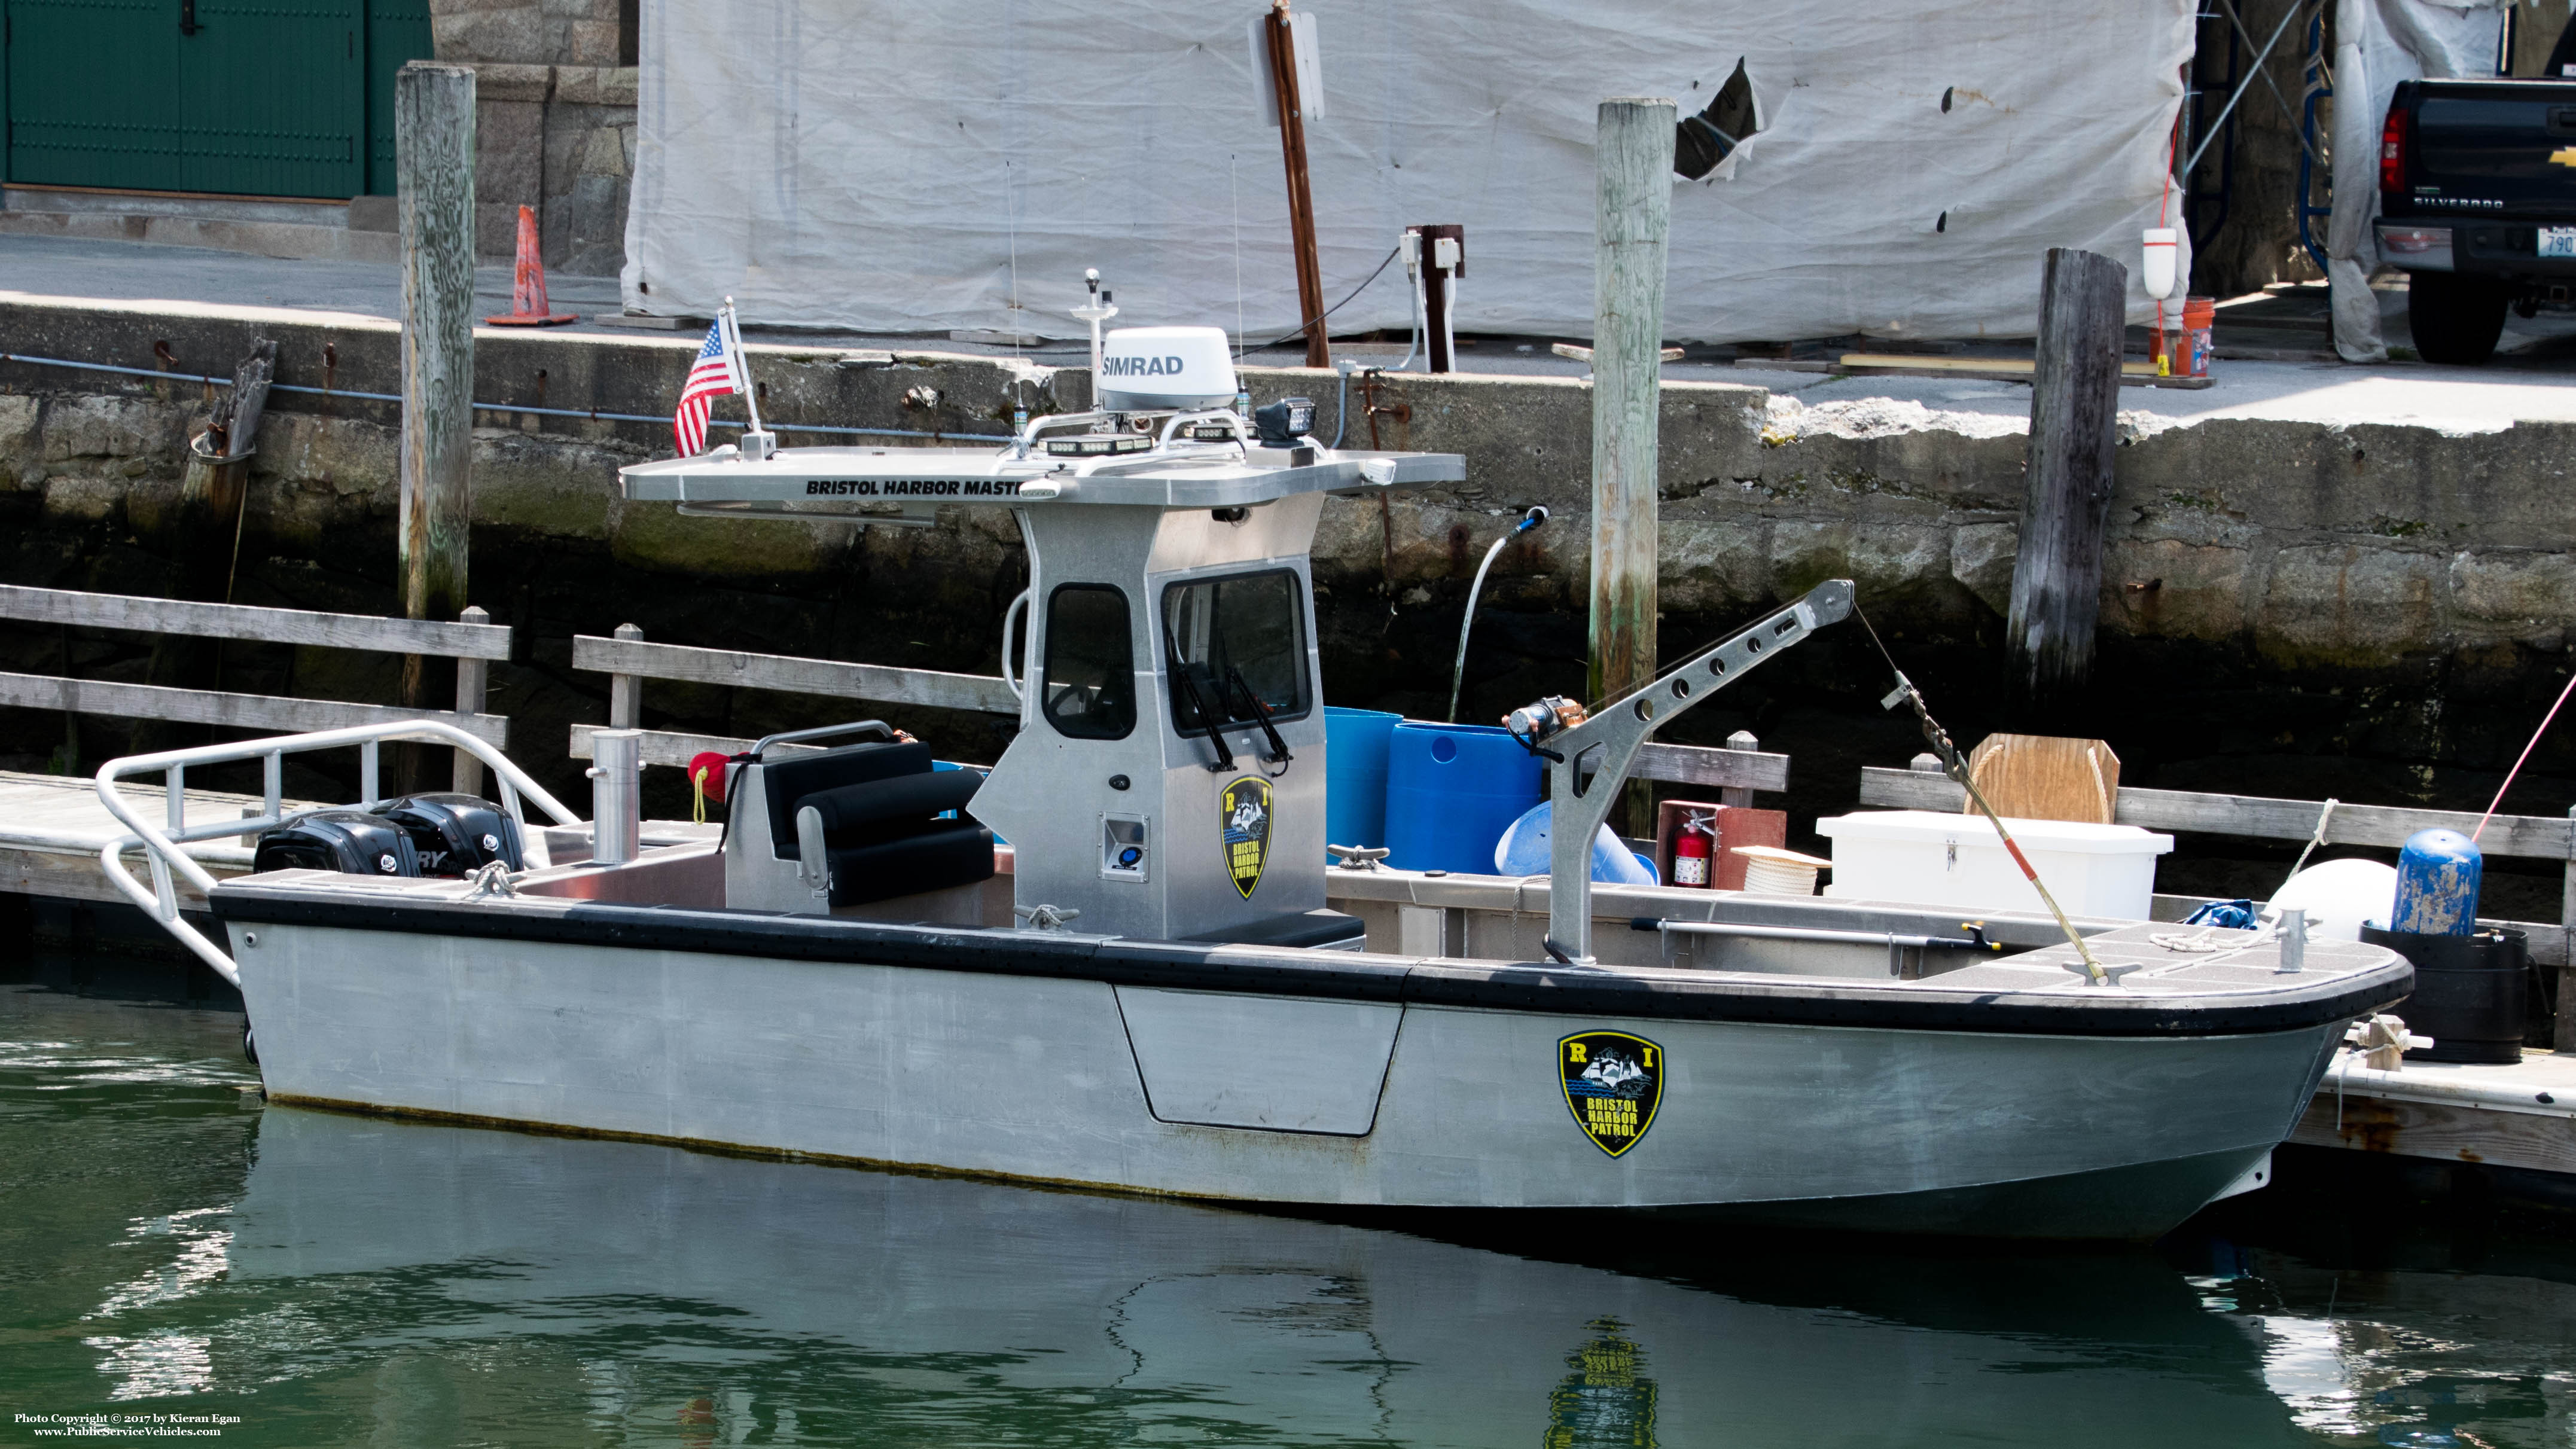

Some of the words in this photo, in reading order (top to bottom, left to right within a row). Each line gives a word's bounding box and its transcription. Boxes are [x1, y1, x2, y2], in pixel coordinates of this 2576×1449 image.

[2414, 197, 2504, 208] SILVERADO
[2548, 236, 2576, 252] 790
[1102, 356, 1184, 376] SIMRAD
[806, 481, 879, 495] BRISTOL
[883, 481, 960, 495] HARBOR
[1225, 792, 1234, 812] R
[1263, 787, 1267, 806] I
[1233, 841, 1260, 855] BRISTOL
[1233, 852, 1259, 868] HARBOR
[1235, 865, 1258, 880] PATROL
[1569, 1042, 1587, 1063] R
[1643, 1048, 1653, 1067] I
[1587, 1097, 1638, 1112] BRISTOL
[1588, 1111, 1638, 1125] HARBOR
[1591, 1122, 1636, 1137] PATROL
